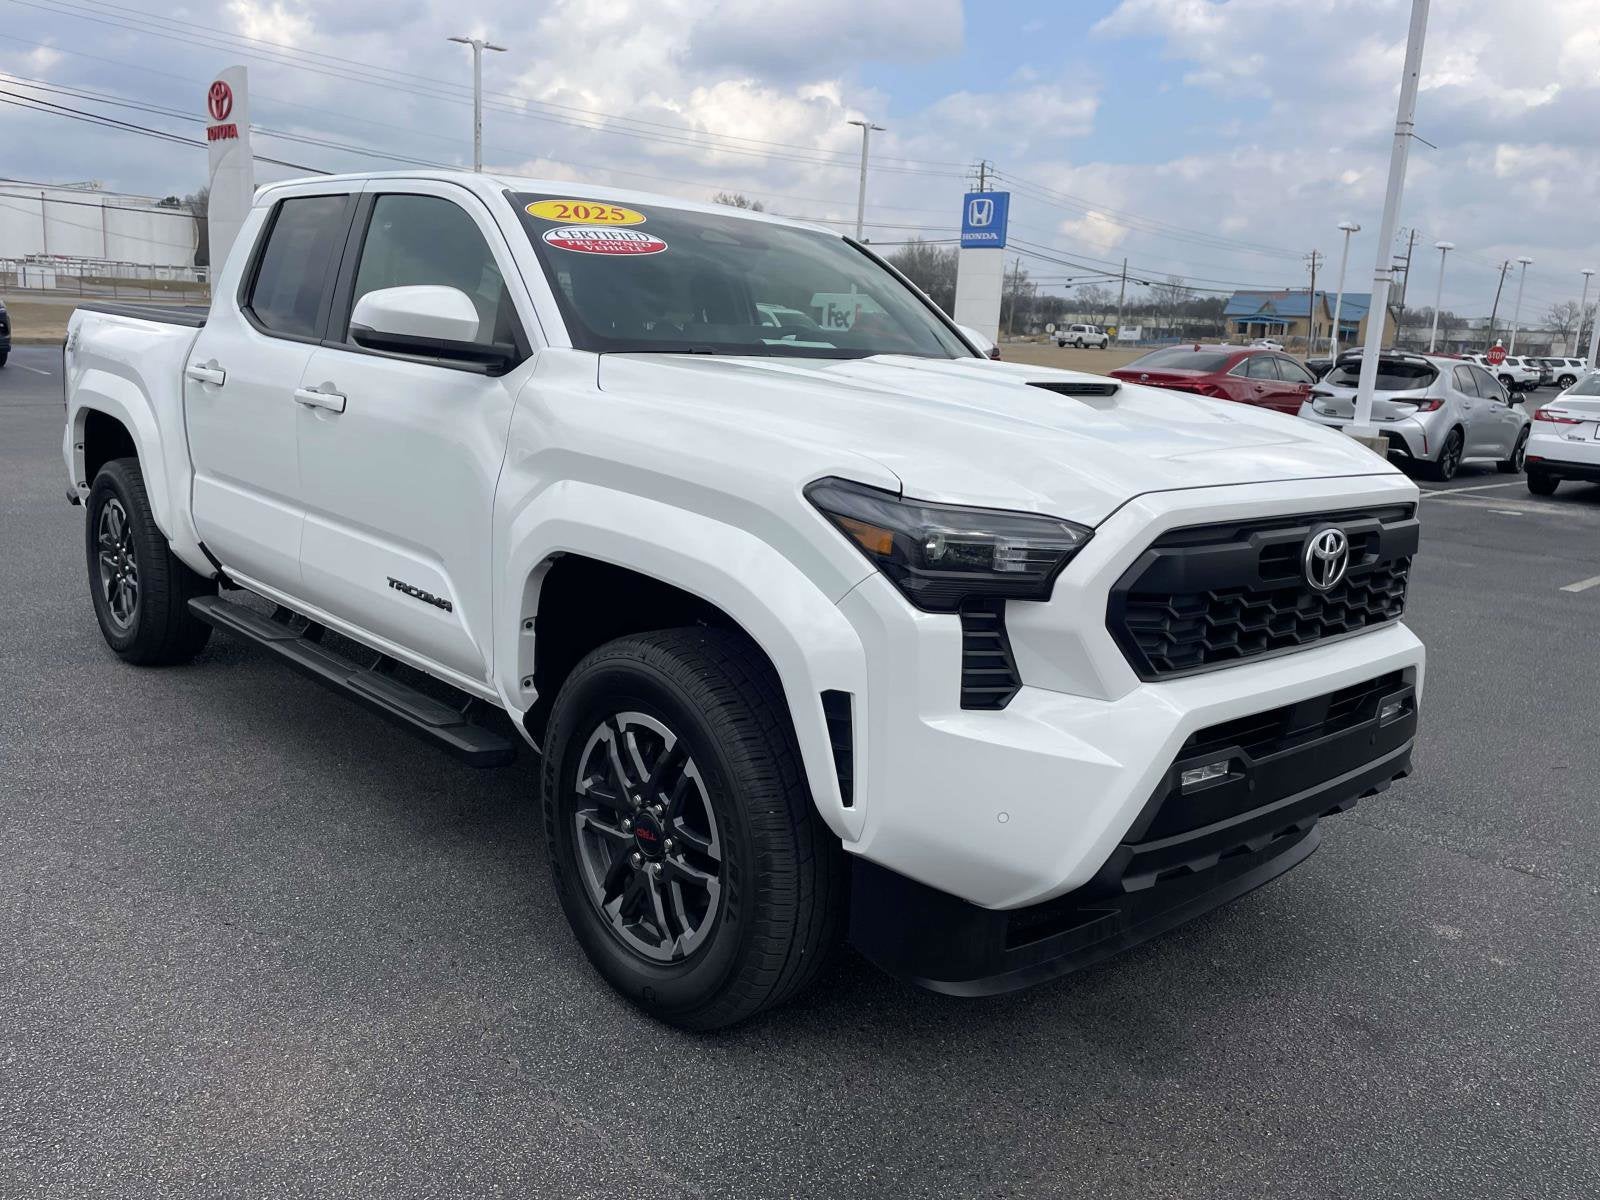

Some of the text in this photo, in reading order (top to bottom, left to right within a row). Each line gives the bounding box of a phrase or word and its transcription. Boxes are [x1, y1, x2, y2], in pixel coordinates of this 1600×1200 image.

[206, 123, 239, 140] TOYOTA
[553, 204, 625, 221] 2025
[555, 230, 650, 243] CERTIFIED
[960, 232, 999, 240] HONDA
[566, 240, 651, 248] PRE-OWNED
[1487, 351, 1506, 360] STOP
[386, 576, 453, 613] TACOMA
